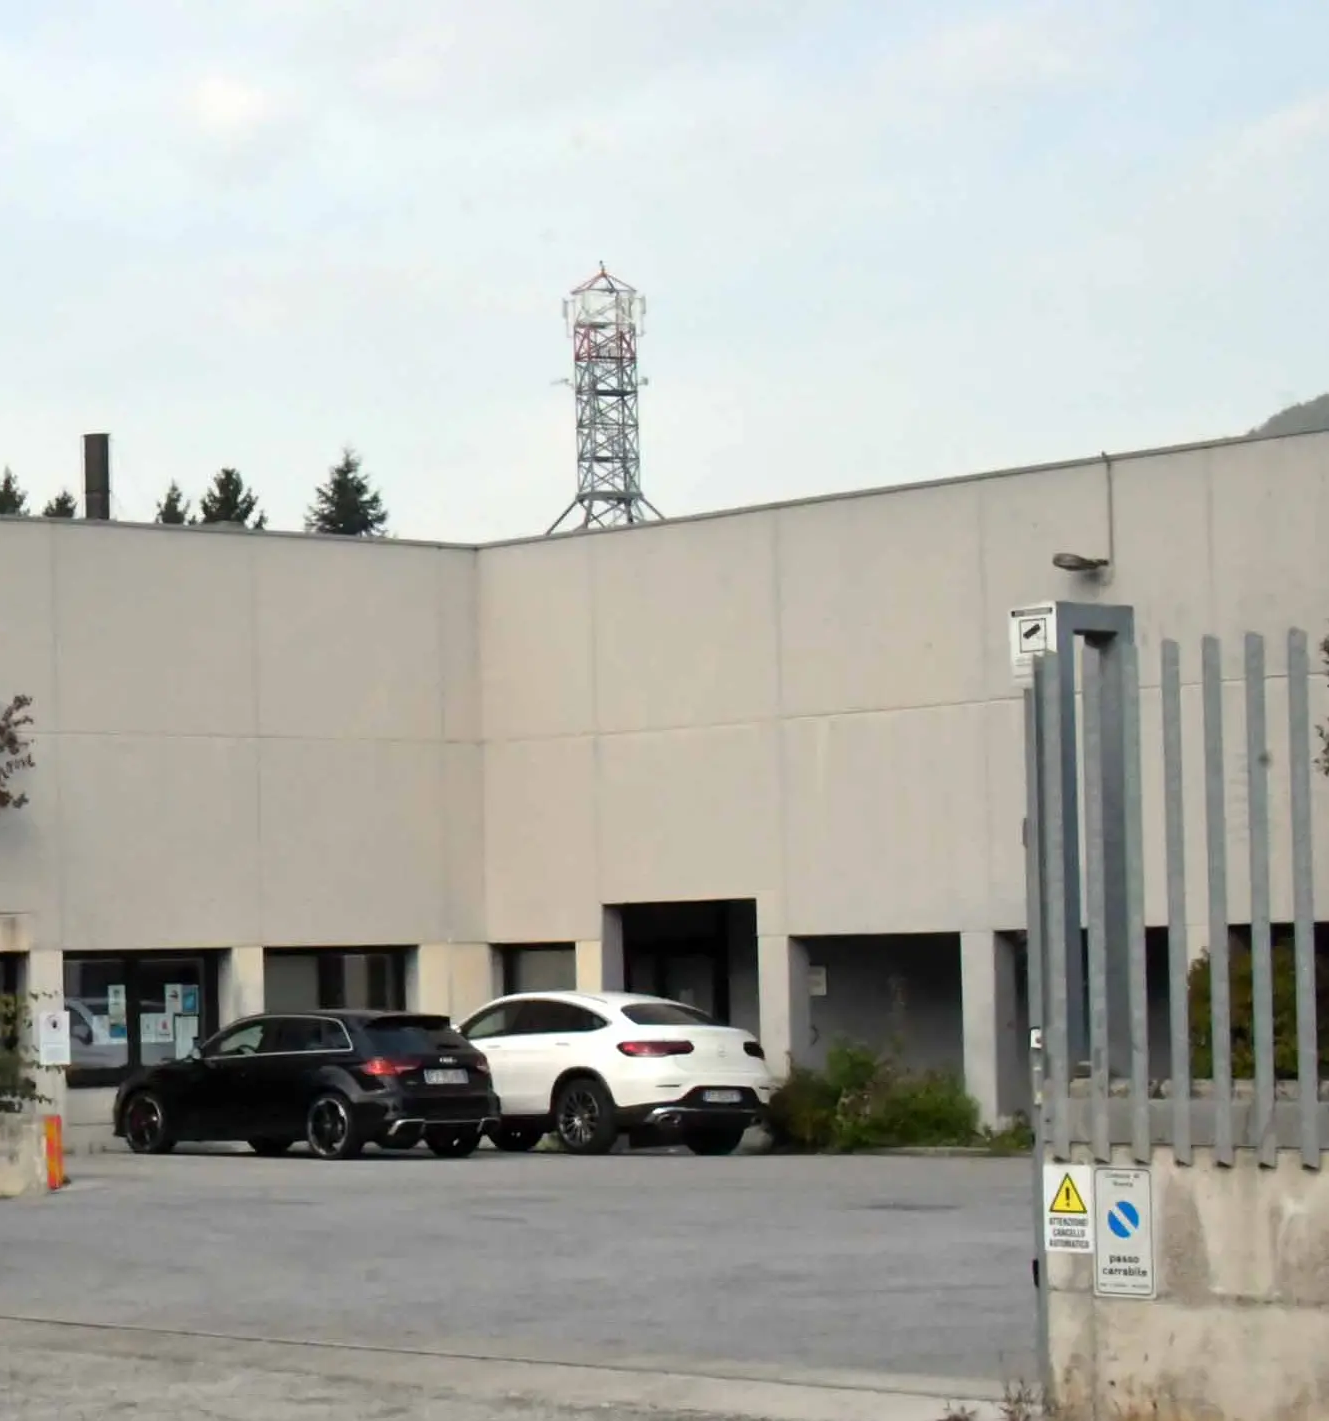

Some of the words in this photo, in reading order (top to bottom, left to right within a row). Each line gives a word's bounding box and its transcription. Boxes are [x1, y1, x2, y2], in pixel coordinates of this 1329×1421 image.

[1052, 1228, 1085, 1238] CANCELLO
[1049, 1239, 1089, 1249] AUTOMATICO
[1109, 1255, 1140, 1265] passo
[1102, 1265, 1148, 1277] carrabile
